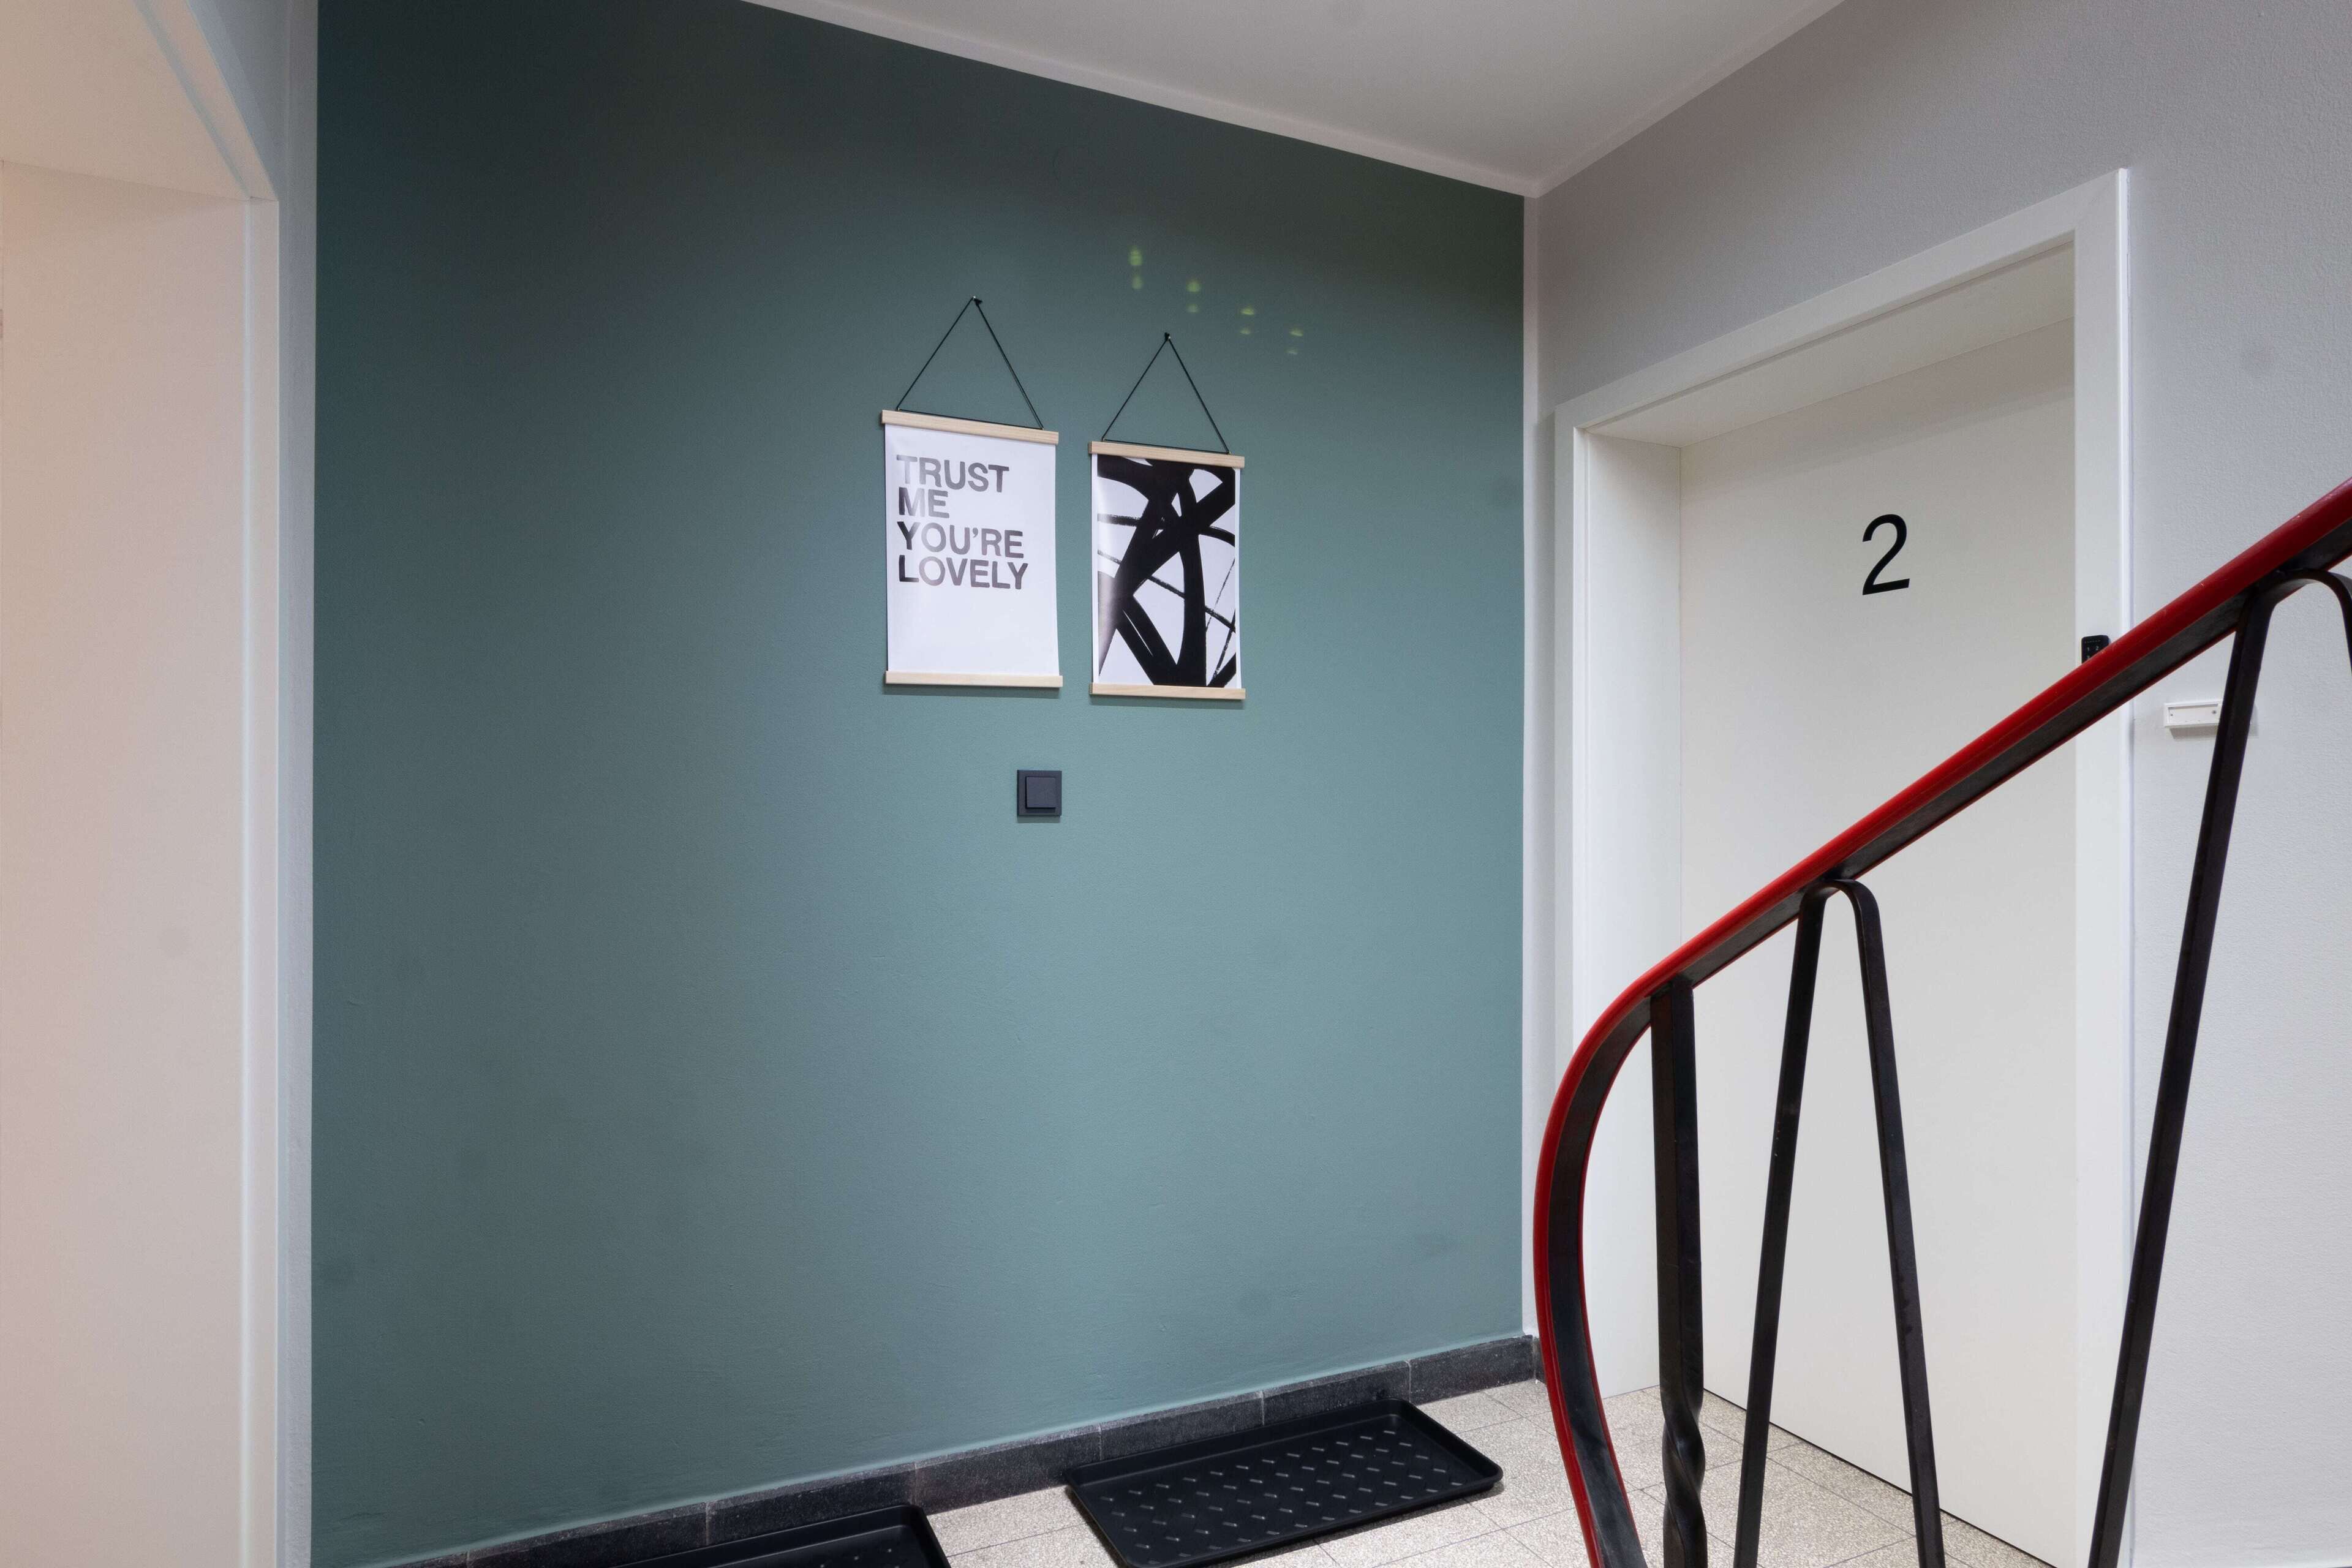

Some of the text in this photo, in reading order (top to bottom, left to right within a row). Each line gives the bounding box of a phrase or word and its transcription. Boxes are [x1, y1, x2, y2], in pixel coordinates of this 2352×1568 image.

[897, 454, 1009, 492] TRUST
[899, 487, 949, 518] ME
[897, 521, 1024, 559] YOU'RE
[1863, 514, 1910, 595] 2
[899, 555, 1028, 590] LOVELY
